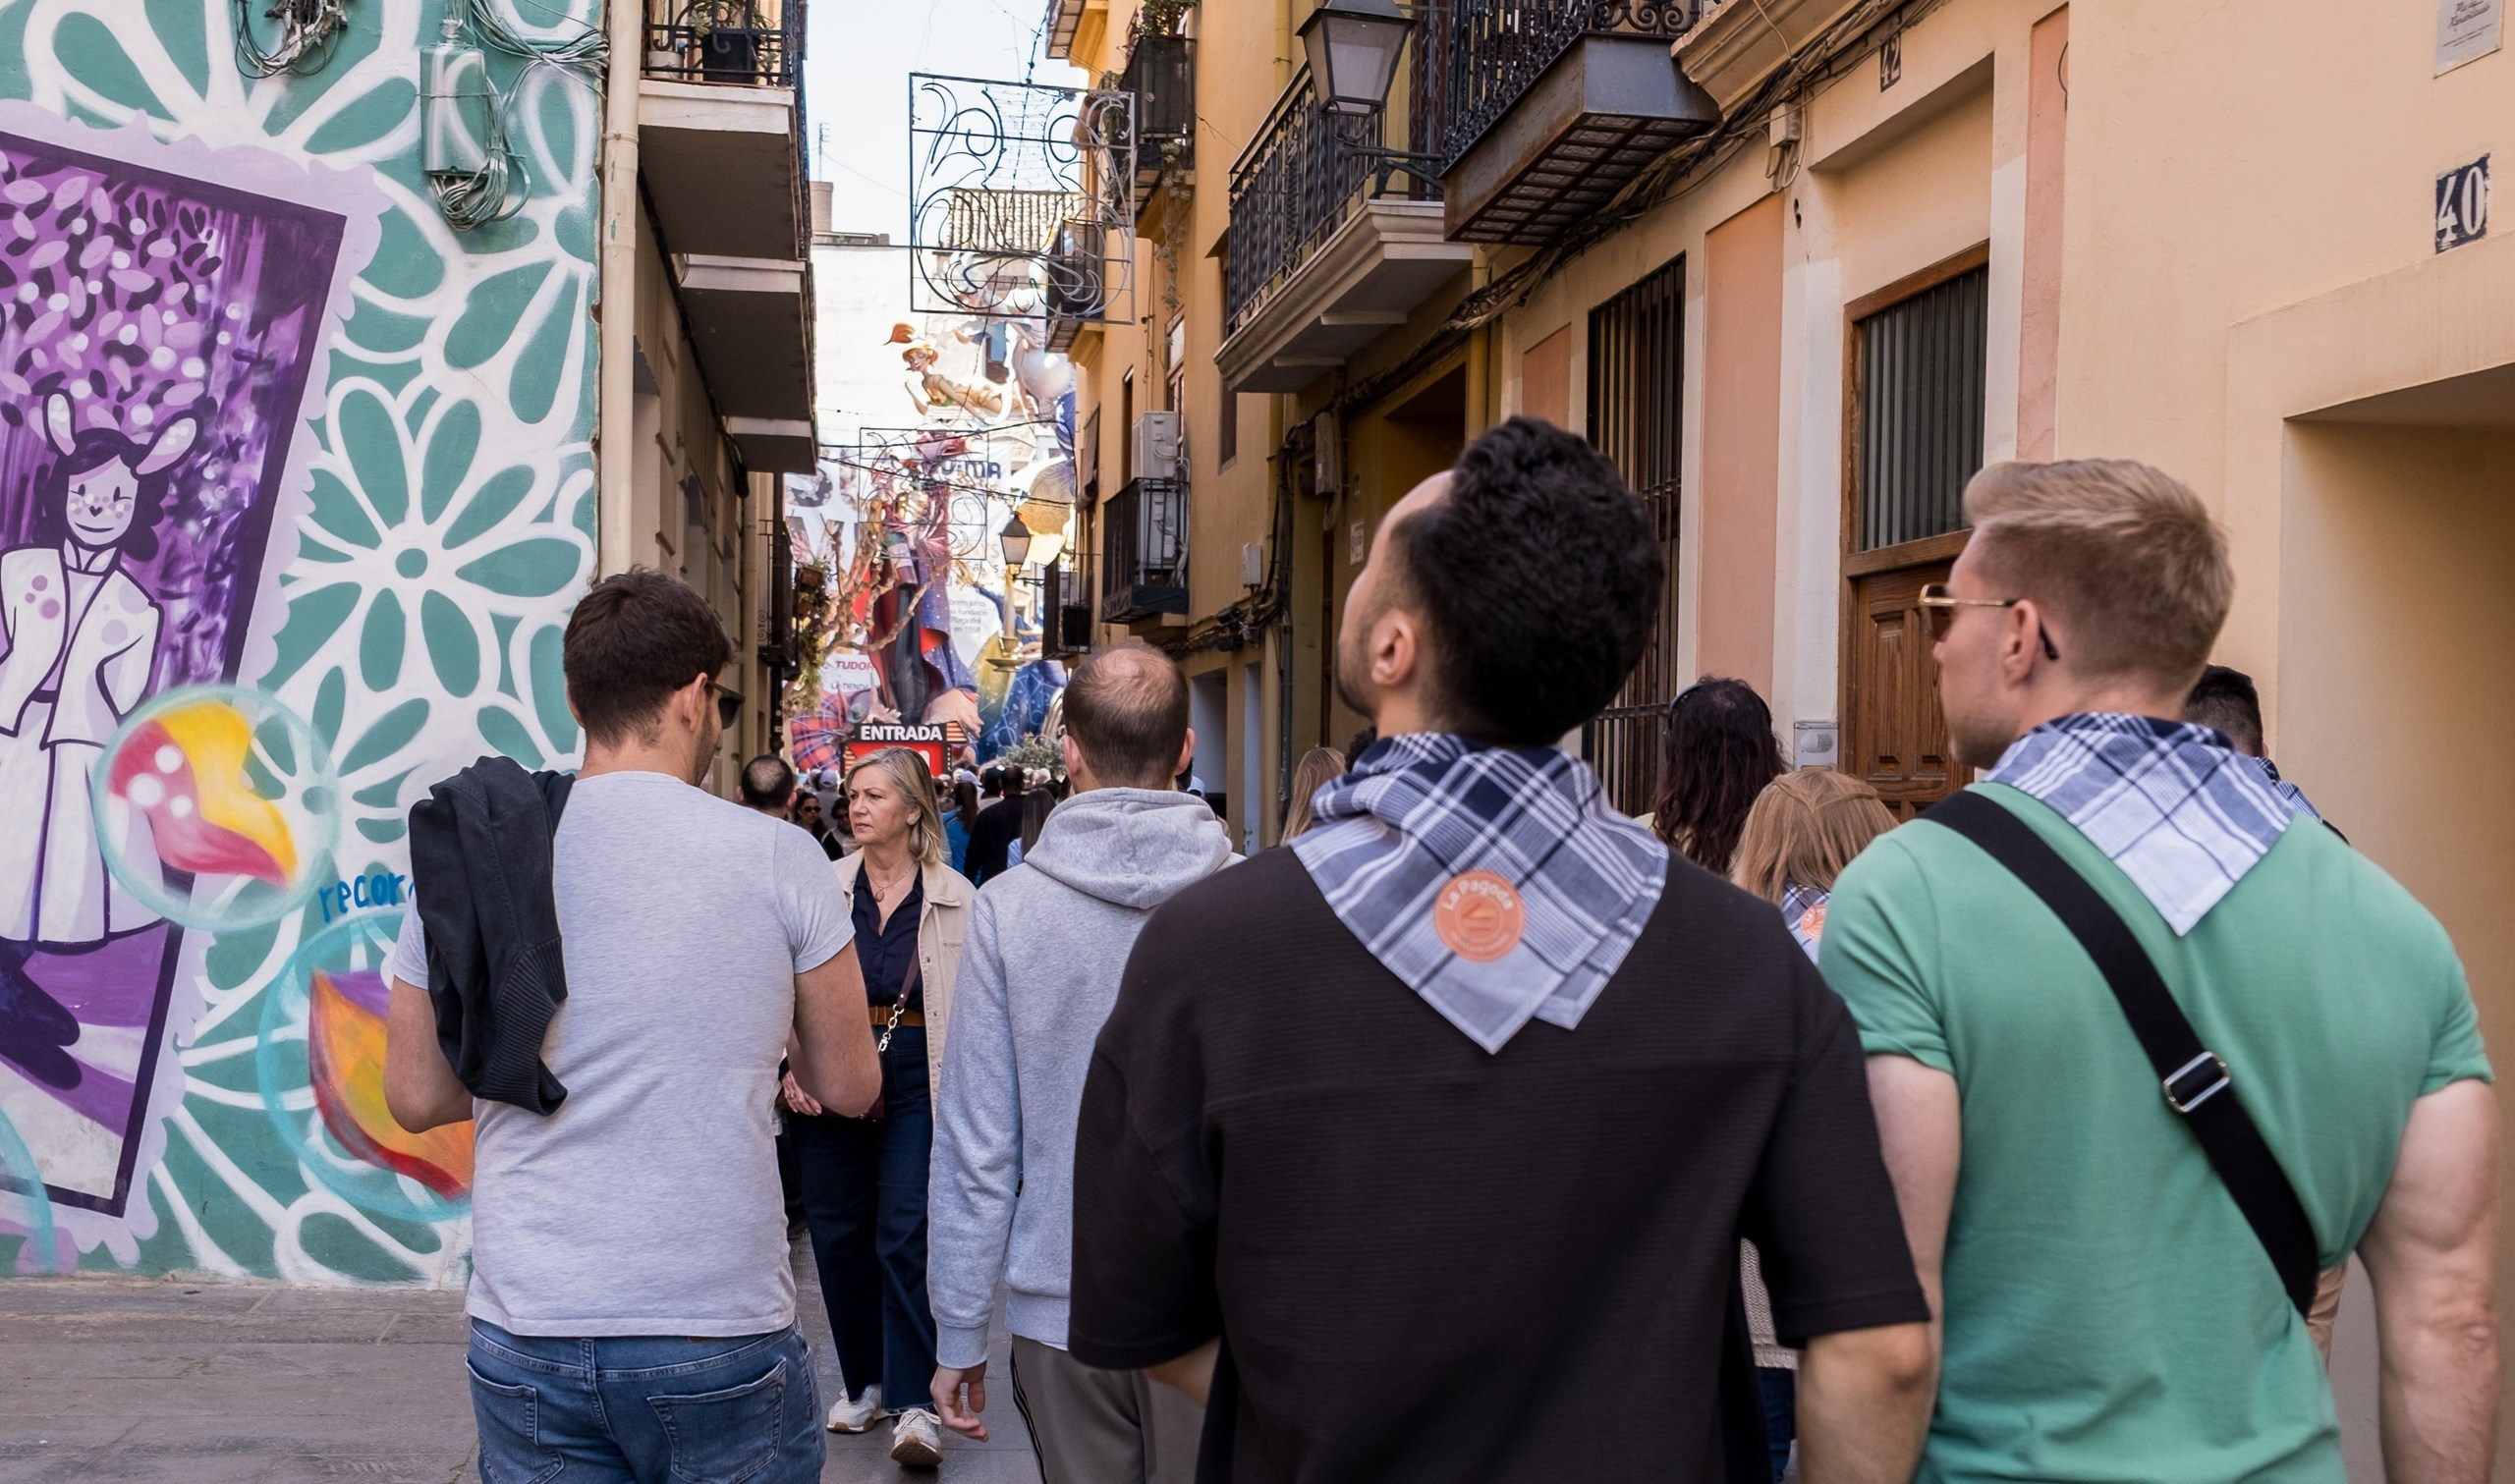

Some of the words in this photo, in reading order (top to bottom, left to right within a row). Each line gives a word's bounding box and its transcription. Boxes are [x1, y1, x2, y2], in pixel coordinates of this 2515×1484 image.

[1881, 32, 1900, 86] 42
[2436, 166, 2487, 242] 40
[860, 725, 943, 742] ENTRADA
[1441, 890, 1461, 911] La
[1457, 878, 1514, 910] Pagoda
